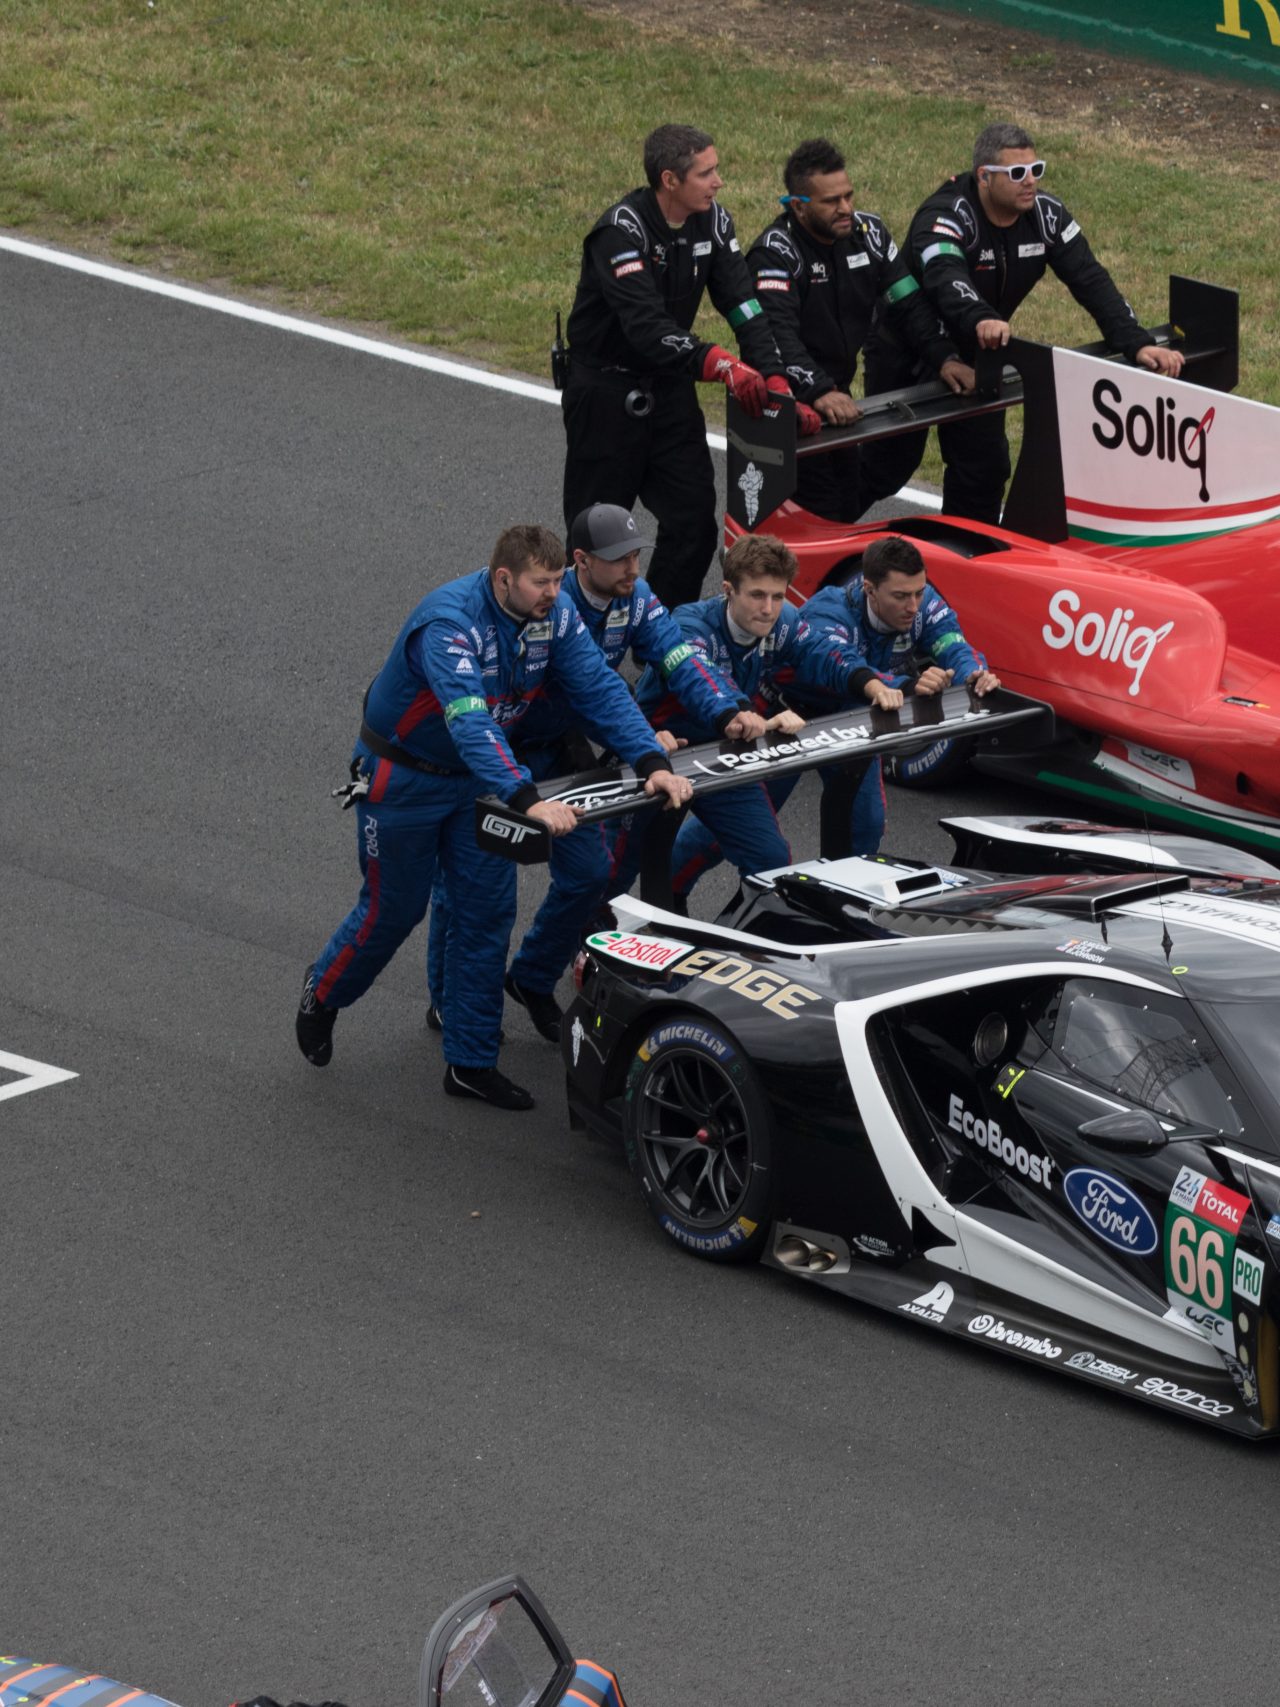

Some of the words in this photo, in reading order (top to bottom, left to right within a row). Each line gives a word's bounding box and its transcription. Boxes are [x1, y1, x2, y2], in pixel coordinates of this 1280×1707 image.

[759, 280, 788, 290] MOTUL
[1091, 378, 1216, 503] Soliq
[664, 643, 693, 671] PITLA
[1042, 589, 1174, 696] Soliq
[717, 730, 837, 768] Powered
[832, 725, 870, 741] by
[908, 737, 950, 776] CHELIN
[364, 815, 379, 858] FORD
[481, 813, 542, 844] GT
[608, 936, 682, 966] Castrol
[671, 950, 823, 1020] EDGE
[659, 1025, 727, 1057] MICHELIN
[948, 1093, 1053, 1190] EcoBoost
[1081, 1179, 1140, 1245] Ford
[1201, 1189, 1239, 1224] TOTAL
[665, 1219, 733, 1250] MICHELIN
[1170, 1216, 1225, 1310] 66
[1235, 1257, 1261, 1297] PRO
[898, 1303, 945, 1324] AXALTA
[1186, 1306, 1225, 1336] WEC
[986, 1321, 1062, 1359] brembo
[1142, 1377, 1234, 1415] sparco
